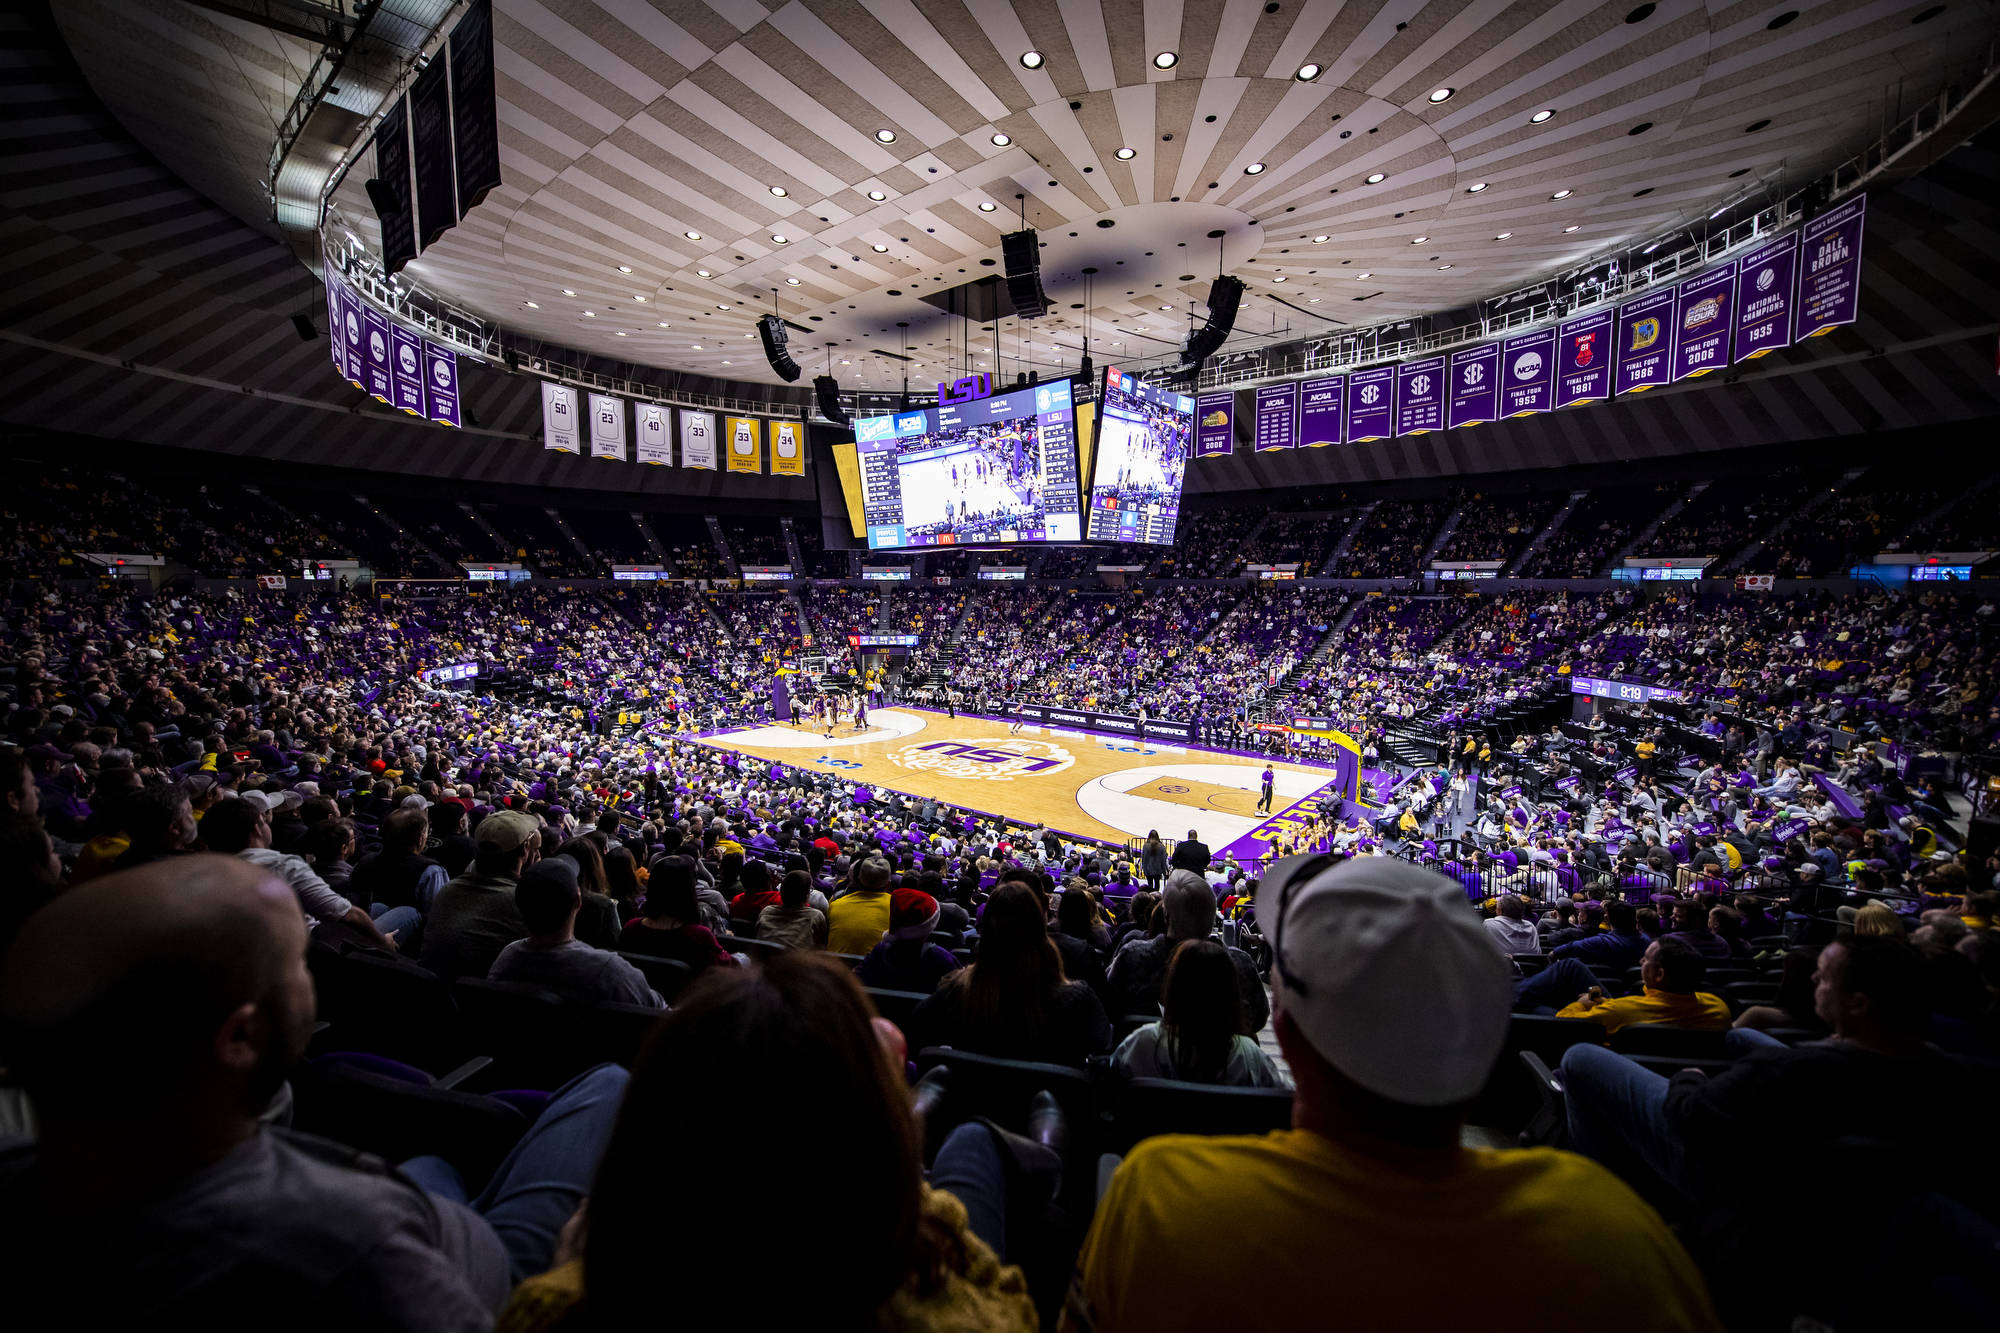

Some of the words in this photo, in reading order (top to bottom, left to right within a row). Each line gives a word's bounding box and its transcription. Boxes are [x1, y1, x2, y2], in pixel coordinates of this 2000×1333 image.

[1818, 237, 1844, 258] DALE
[1812, 246, 1849, 273] BROWN
[1747, 292, 1781, 313] NATIONAL
[1687, 308, 1715, 324] FOUR
[1742, 300, 1785, 323] CHAMPIONS
[1749, 323, 1773, 342] 1935
[1580, 343, 1589, 352] 81
[1685, 343, 1702, 354] FINAL
[1702, 337, 1720, 349] FOUR
[1626, 361, 1643, 371] FINAL
[1643, 356, 1660, 367] FOUR
[1688, 348, 1715, 365] 2006
[1463, 362, 1484, 385] SEC
[1517, 363, 1541, 374] NCAA
[1630, 366, 1654, 382] 1986
[1410, 374, 1431, 396] SEC
[1566, 376, 1582, 386] FINAL
[1583, 372, 1599, 382] FOUR
[938, 371, 993, 406] LSU
[1360, 384, 1380, 404] SEC
[1510, 389, 1526, 398] FINAL
[1527, 386, 1542, 395] FOUR
[1571, 382, 1592, 395] 1981
[1265, 398, 1285, 408] NCAA
[1310, 392, 1332, 402] NCAA
[1514, 394, 1536, 407] 1953
[555, 403, 567, 415] 50
[602, 412, 614, 424] 23
[1047, 412, 1063, 422] LSU
[648, 421, 659, 431] 40
[692, 427, 705, 437] 33
[862, 420, 890, 440] Sprite
[738, 432, 749, 442] 33
[781, 436, 792, 445] 34
[1205, 441, 1223, 450] 2008
[1033, 531, 1045, 539] LSU
[1596, 687, 1607, 696] 48
[1620, 685, 1642, 699] 9:19
[1007, 707, 1042, 717] PORADE
[1050, 712, 1087, 723] POWERADE
[1096, 718, 1136, 730] POWERADE
[1144, 724, 1188, 736] POWERADE
[916, 742, 1063, 771] LSU
